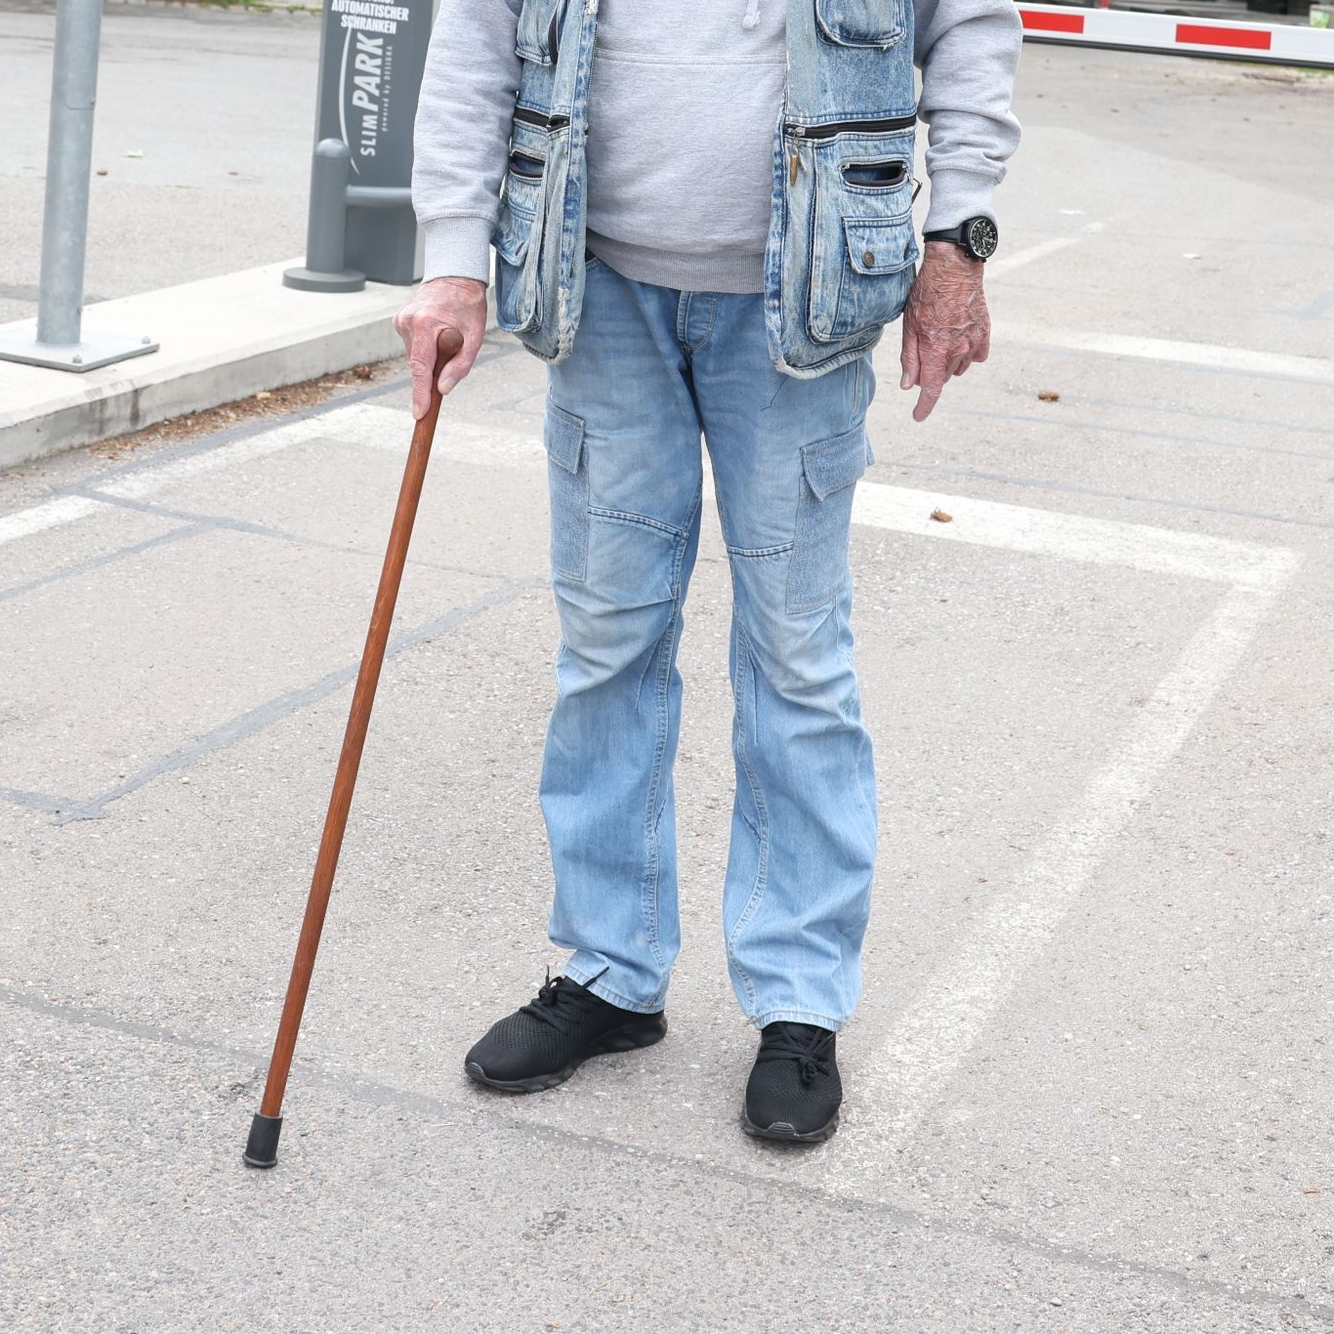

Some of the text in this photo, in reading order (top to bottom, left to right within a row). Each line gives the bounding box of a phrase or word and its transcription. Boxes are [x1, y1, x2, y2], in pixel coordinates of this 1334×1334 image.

[340, 14, 397, 35] SCHRANKEN
[352, 31, 384, 157] SLIM PARK
